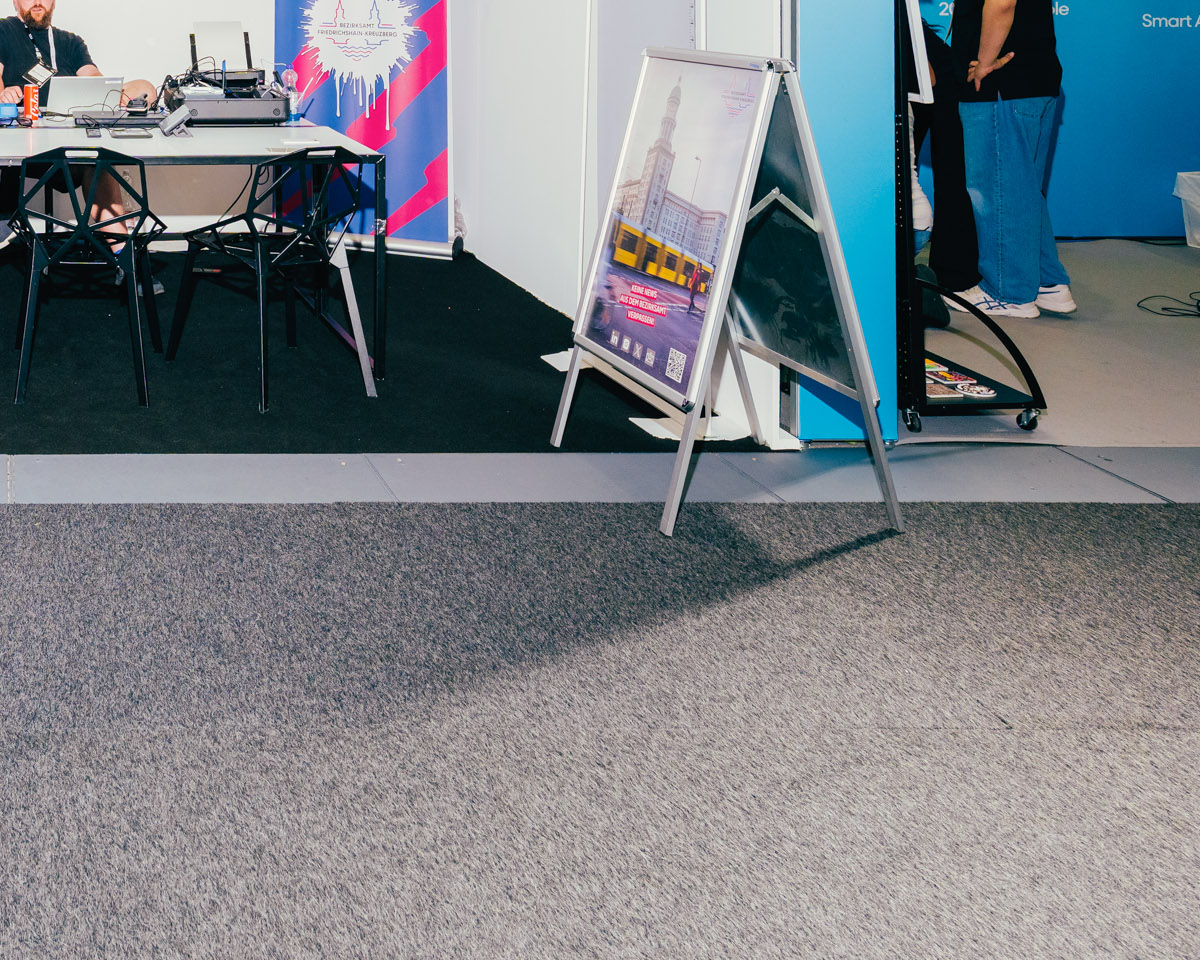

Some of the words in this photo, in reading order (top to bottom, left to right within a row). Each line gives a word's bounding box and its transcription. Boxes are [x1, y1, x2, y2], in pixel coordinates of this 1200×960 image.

[1142, 14, 1192, 28] Smart
[632, 284, 644, 294] KEINE
[645, 287, 657, 299] NEWS
[628, 297, 640, 308] DEM
[640, 300, 667, 315] BEZIRKSAMT
